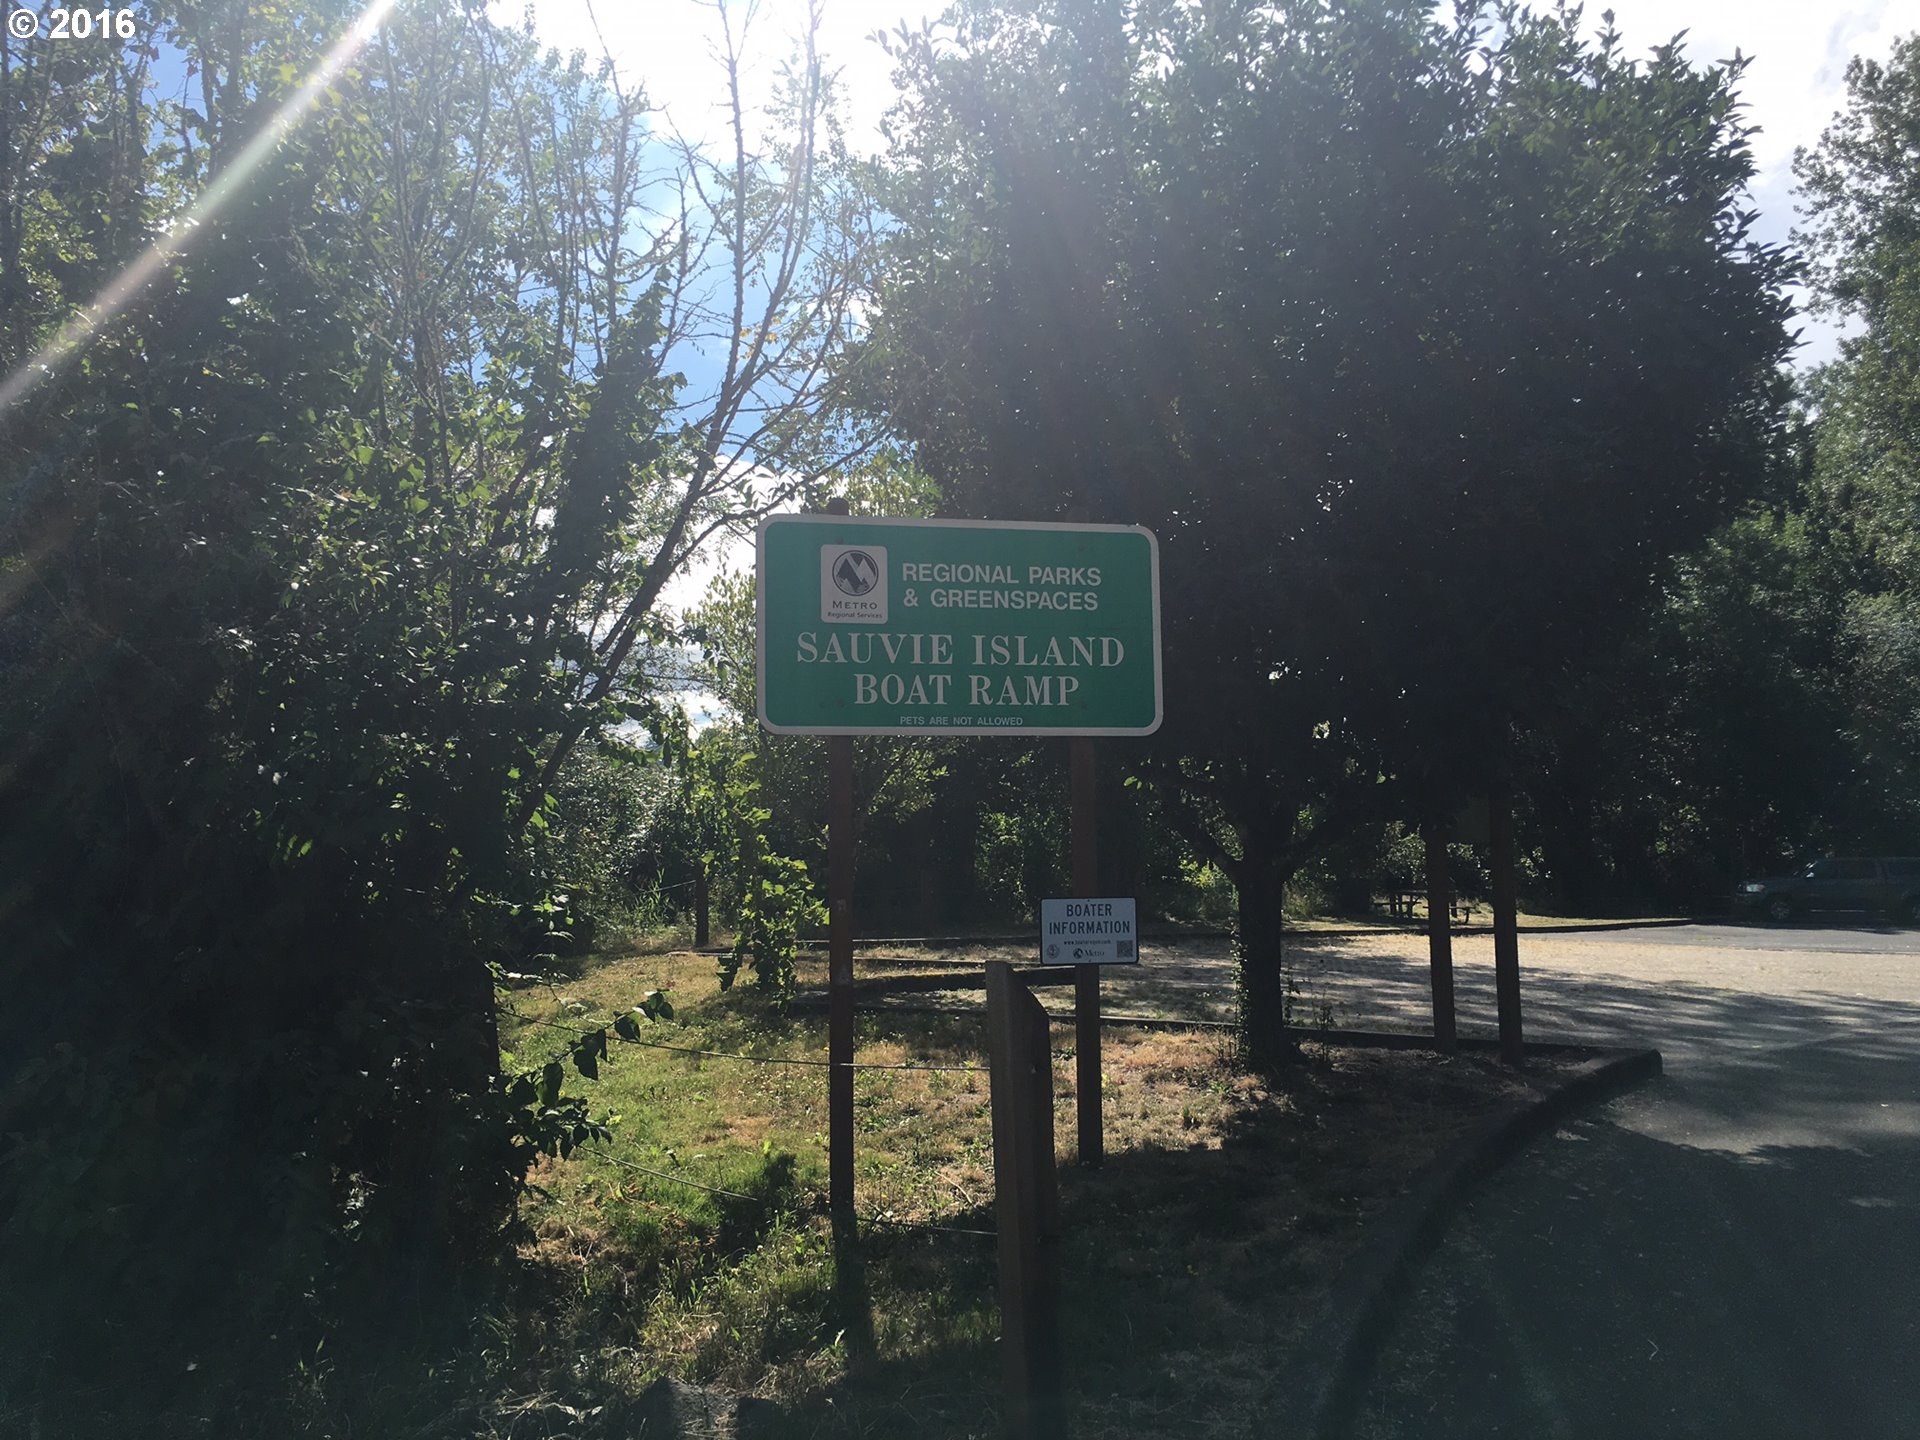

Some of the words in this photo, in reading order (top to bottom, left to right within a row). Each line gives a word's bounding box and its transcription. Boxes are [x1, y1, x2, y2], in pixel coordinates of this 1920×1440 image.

[901, 562, 1019, 585] REGIONAL
[1028, 566, 1102, 587] PARKS
[832, 600, 878, 610] METRO
[903, 588, 919, 607] &
[930, 588, 1099, 611] GREENSPACES
[827, 611, 856, 619] Regional
[796, 631, 954, 665] SAUVIE
[972, 634, 1125, 667] ISLAND
[853, 673, 952, 706] BOAT
[969, 674, 1080, 707] RAMP
[899, 716, 926, 726] PETS
[929, 716, 949, 726] ARE
[953, 716, 973, 726] NOT
[977, 716, 1023, 727] ALLOWED
[1066, 903, 1113, 917] BOATER
[1048, 920, 1130, 935] INFORMATION
